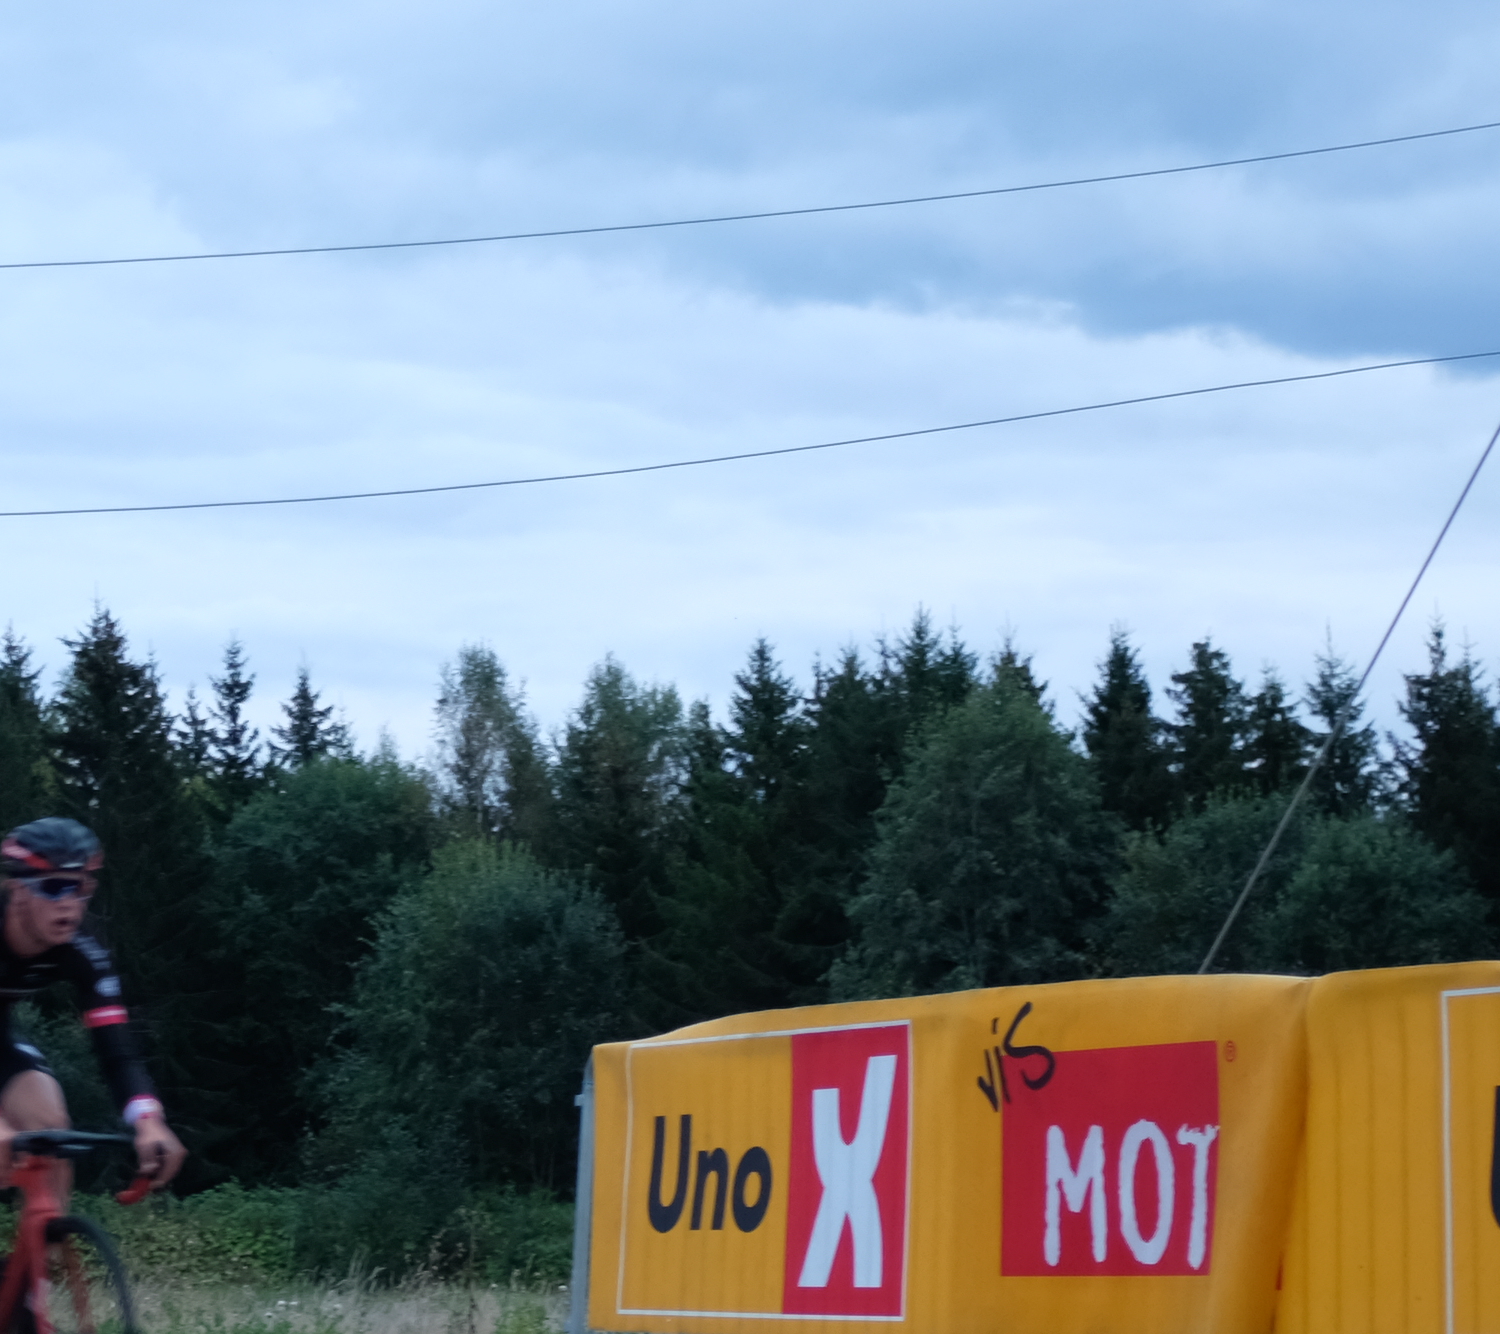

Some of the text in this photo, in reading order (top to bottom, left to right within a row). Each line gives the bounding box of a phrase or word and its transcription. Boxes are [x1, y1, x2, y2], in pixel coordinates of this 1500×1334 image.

[647, 1054, 897, 1288] Uno X
[1043, 1119, 1221, 1270] MOT
